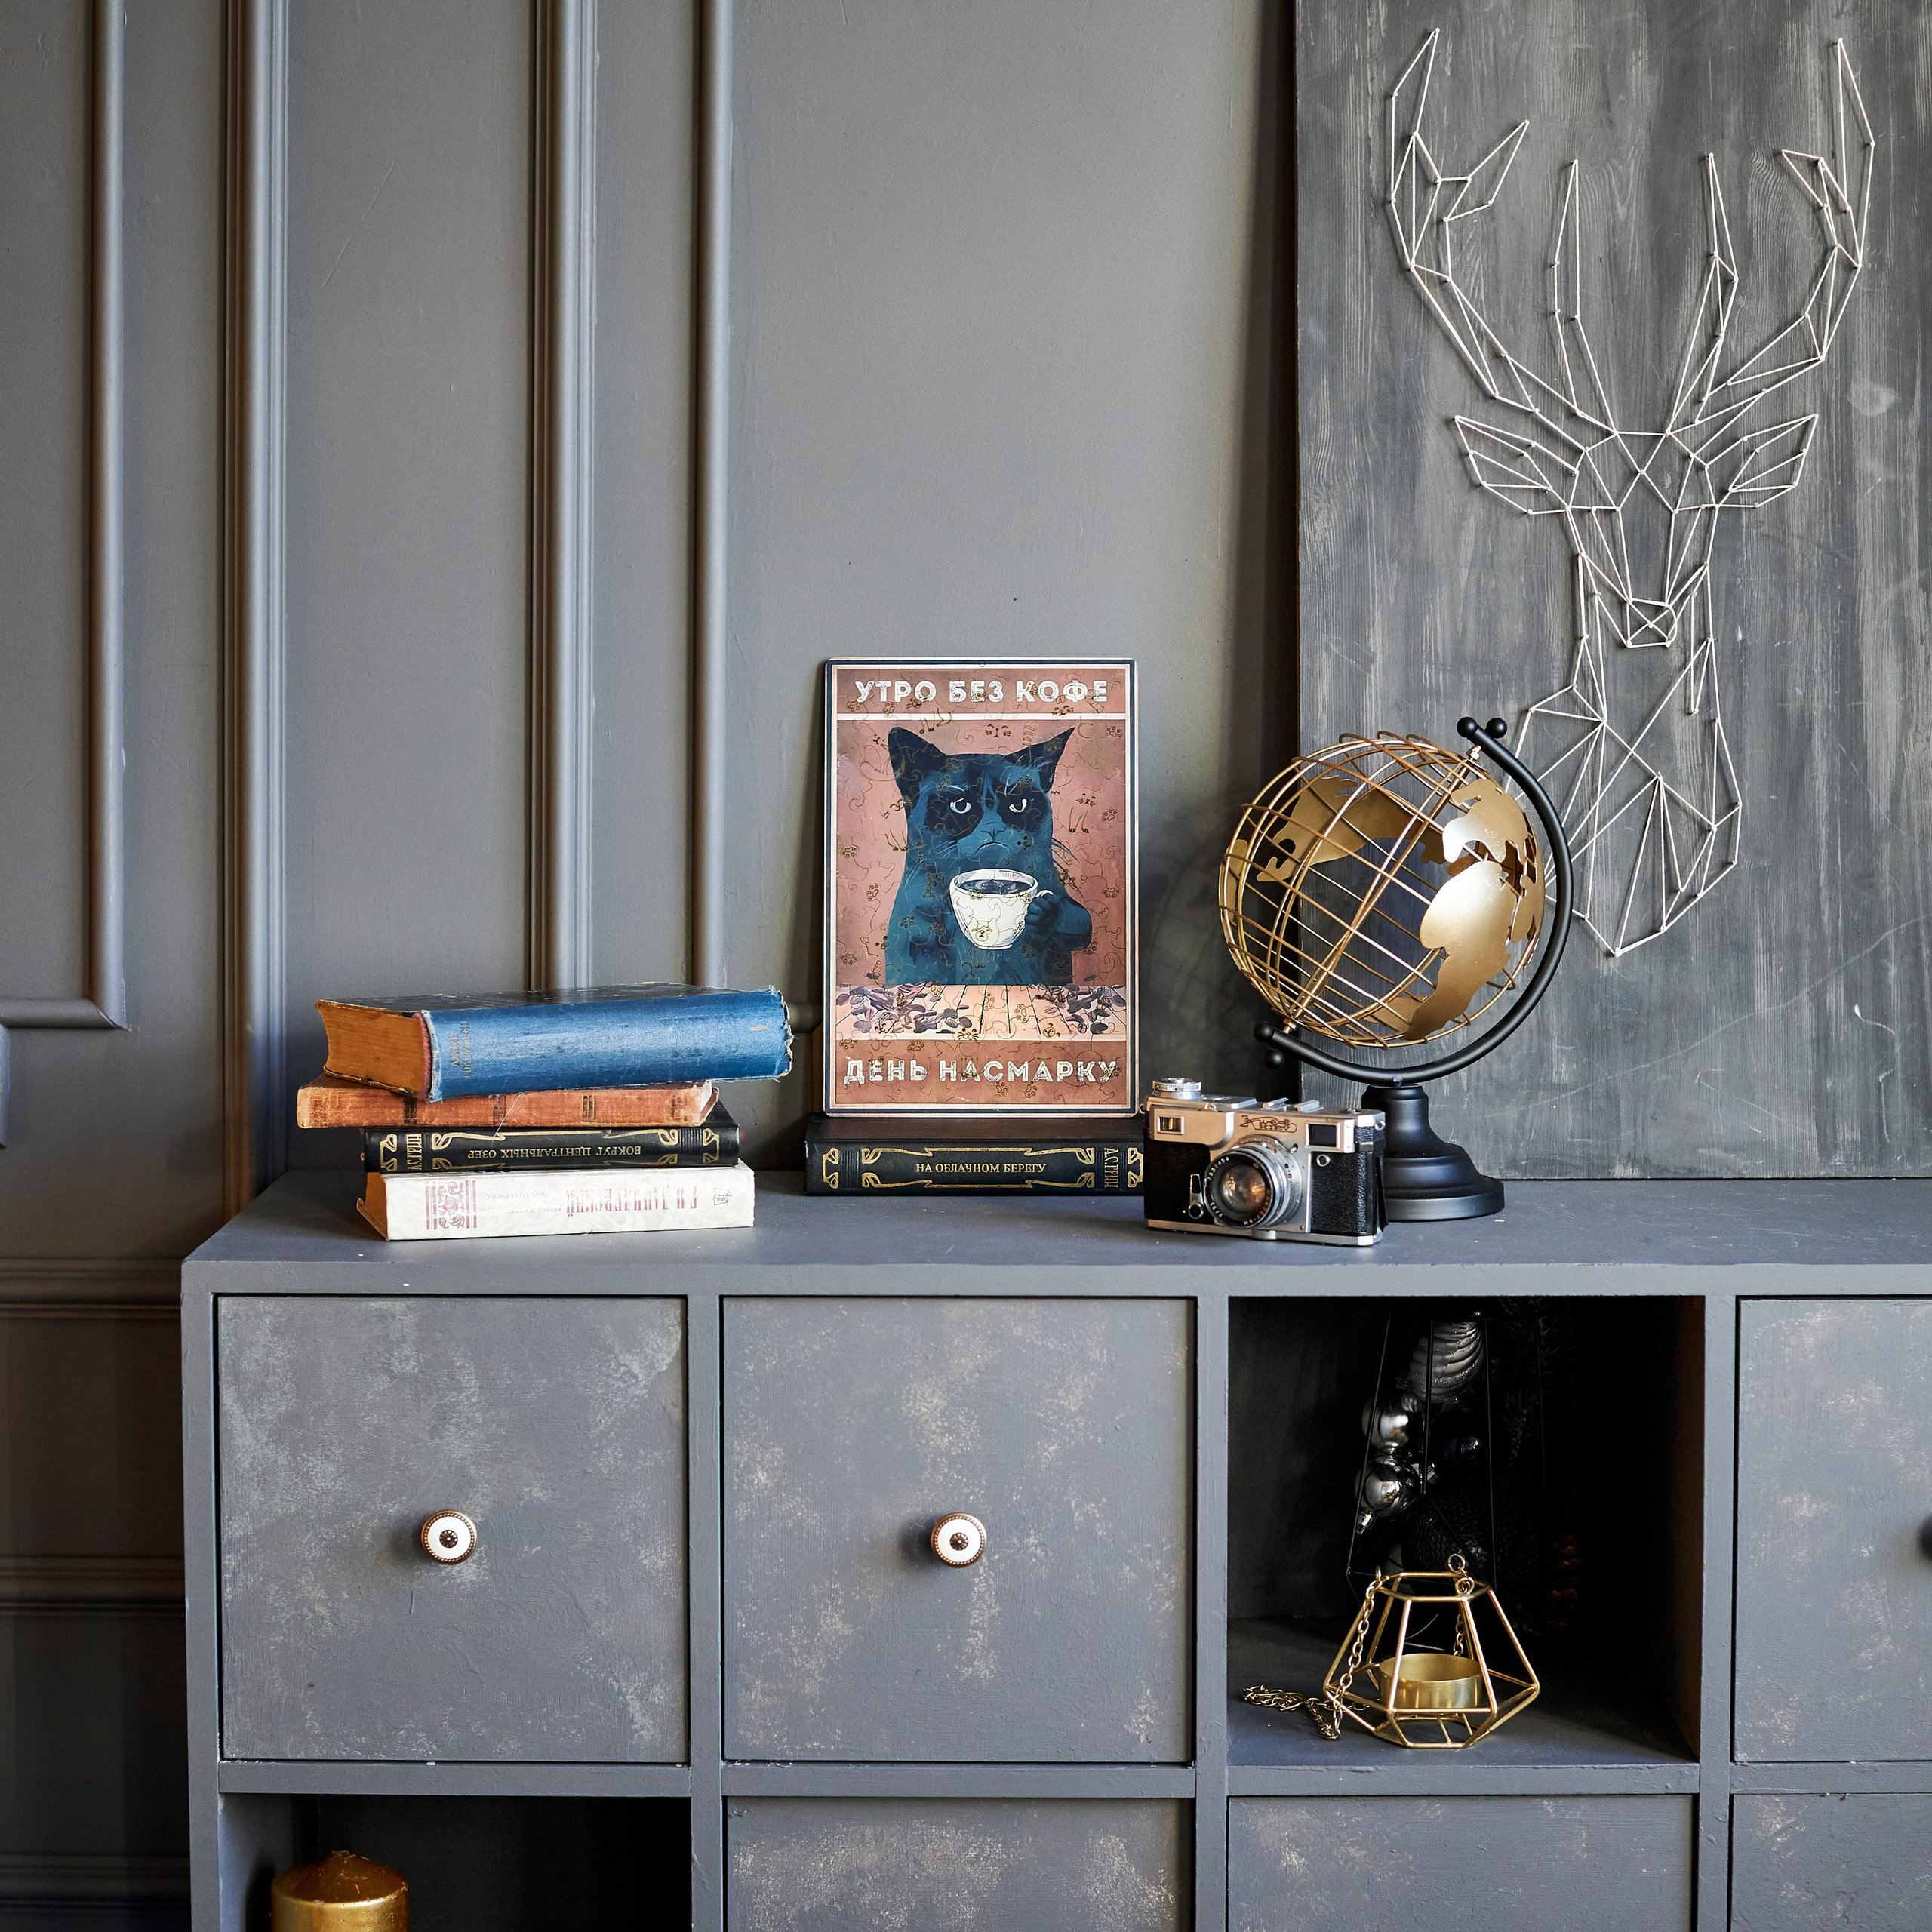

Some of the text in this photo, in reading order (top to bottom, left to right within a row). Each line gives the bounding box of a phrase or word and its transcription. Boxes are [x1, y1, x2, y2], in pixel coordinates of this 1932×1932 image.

[854, 680, 1108, 703] УТРО БЕЗ КОФЕ
[843, 1060, 1117, 1085] ДЕНЬ НАСМАРКУ
[467, 1146, 641, 1159] ВОКРУГ ЦЕНТРАЛЬНЫХ ОЗЕР
[915, 1163, 1047, 1174] НА ОБЛАЧНОМ БЕРЕГУ
[1104, 1147, 1118, 1188] А.С.ГРИН
